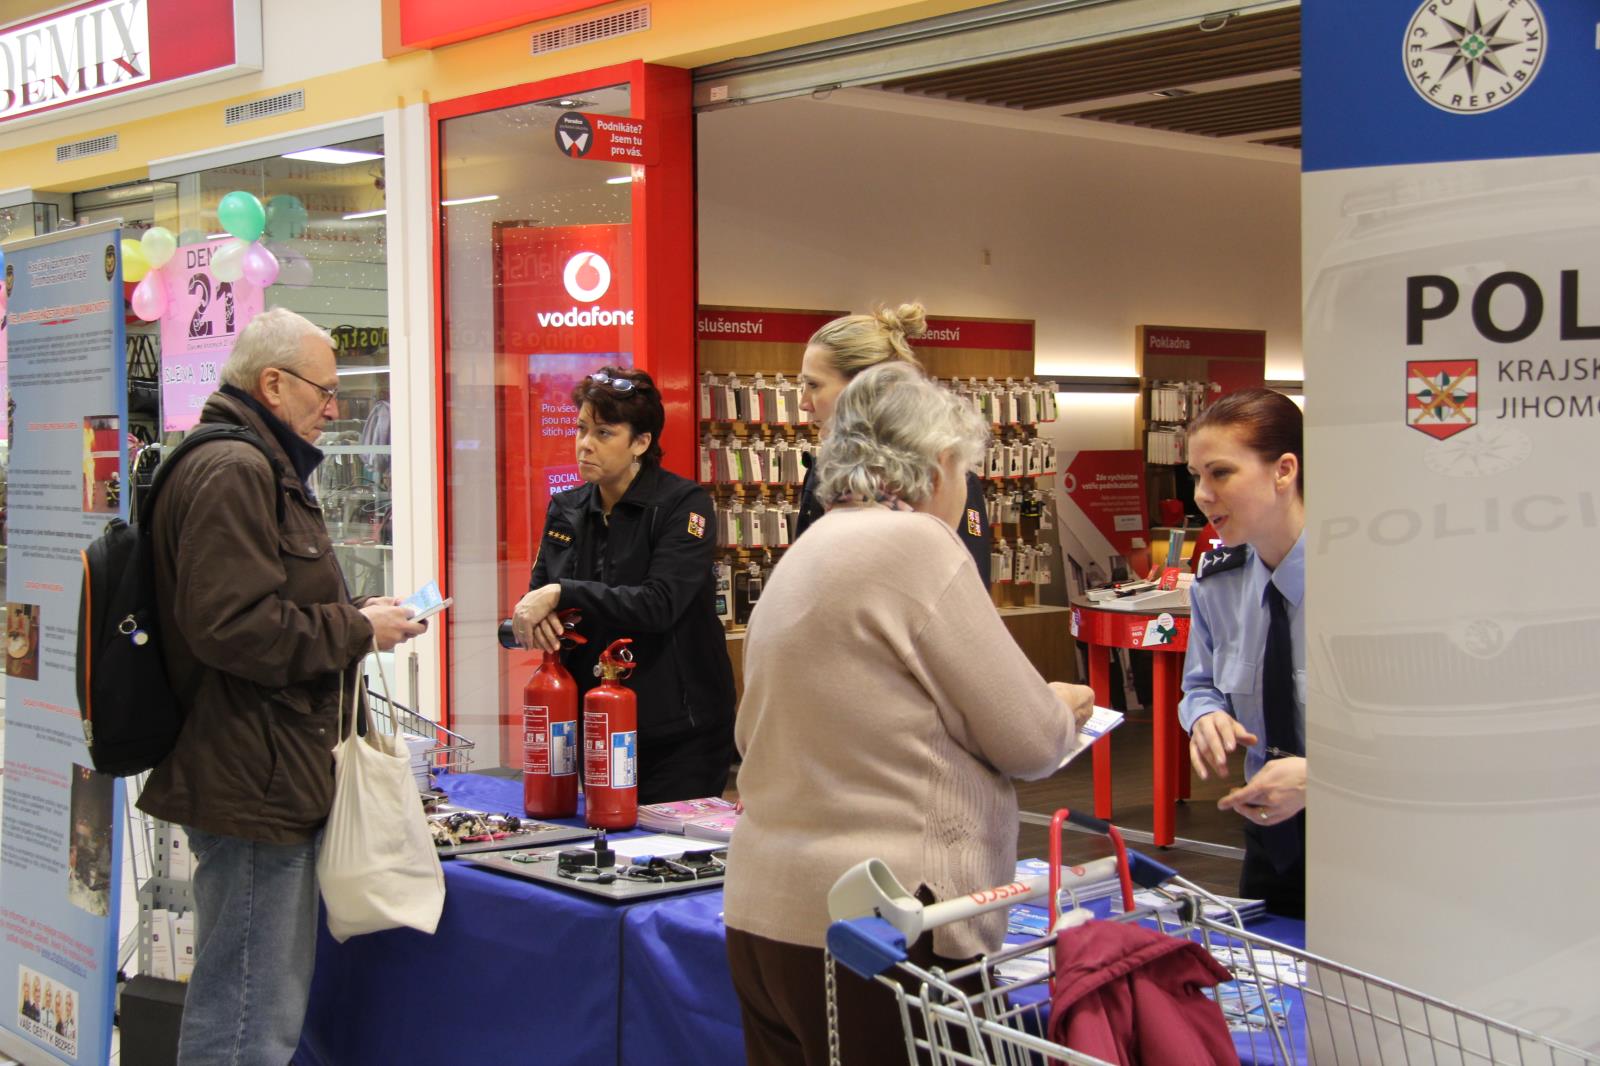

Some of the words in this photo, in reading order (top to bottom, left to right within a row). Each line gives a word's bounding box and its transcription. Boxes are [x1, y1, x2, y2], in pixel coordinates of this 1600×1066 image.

[1410, 27, 1442, 96] ČESKÉ
[1451, 16, 1539, 107] REPUBLIKY
[597, 120, 642, 134] Podnikáte?
[610, 133, 632, 143] Jsem
[633, 136, 642, 145] tu
[611, 147, 625, 156] pro
[626, 147, 643, 157] vás.
[188, 272, 235, 338] 21
[537, 306, 634, 327] vodafone
[698, 317, 763, 334] slušenství
[1150, 335, 1191, 350] Pokladna
[541, 403, 556, 413] Pro
[557, 404, 578, 413] všec
[1497, 395, 1600, 419] JIHOM
[541, 416, 559, 426] jsou
[560, 417, 571, 425] na
[548, 473, 580, 485] SOCIAL
[968, 881, 1031, 905] TESCO
